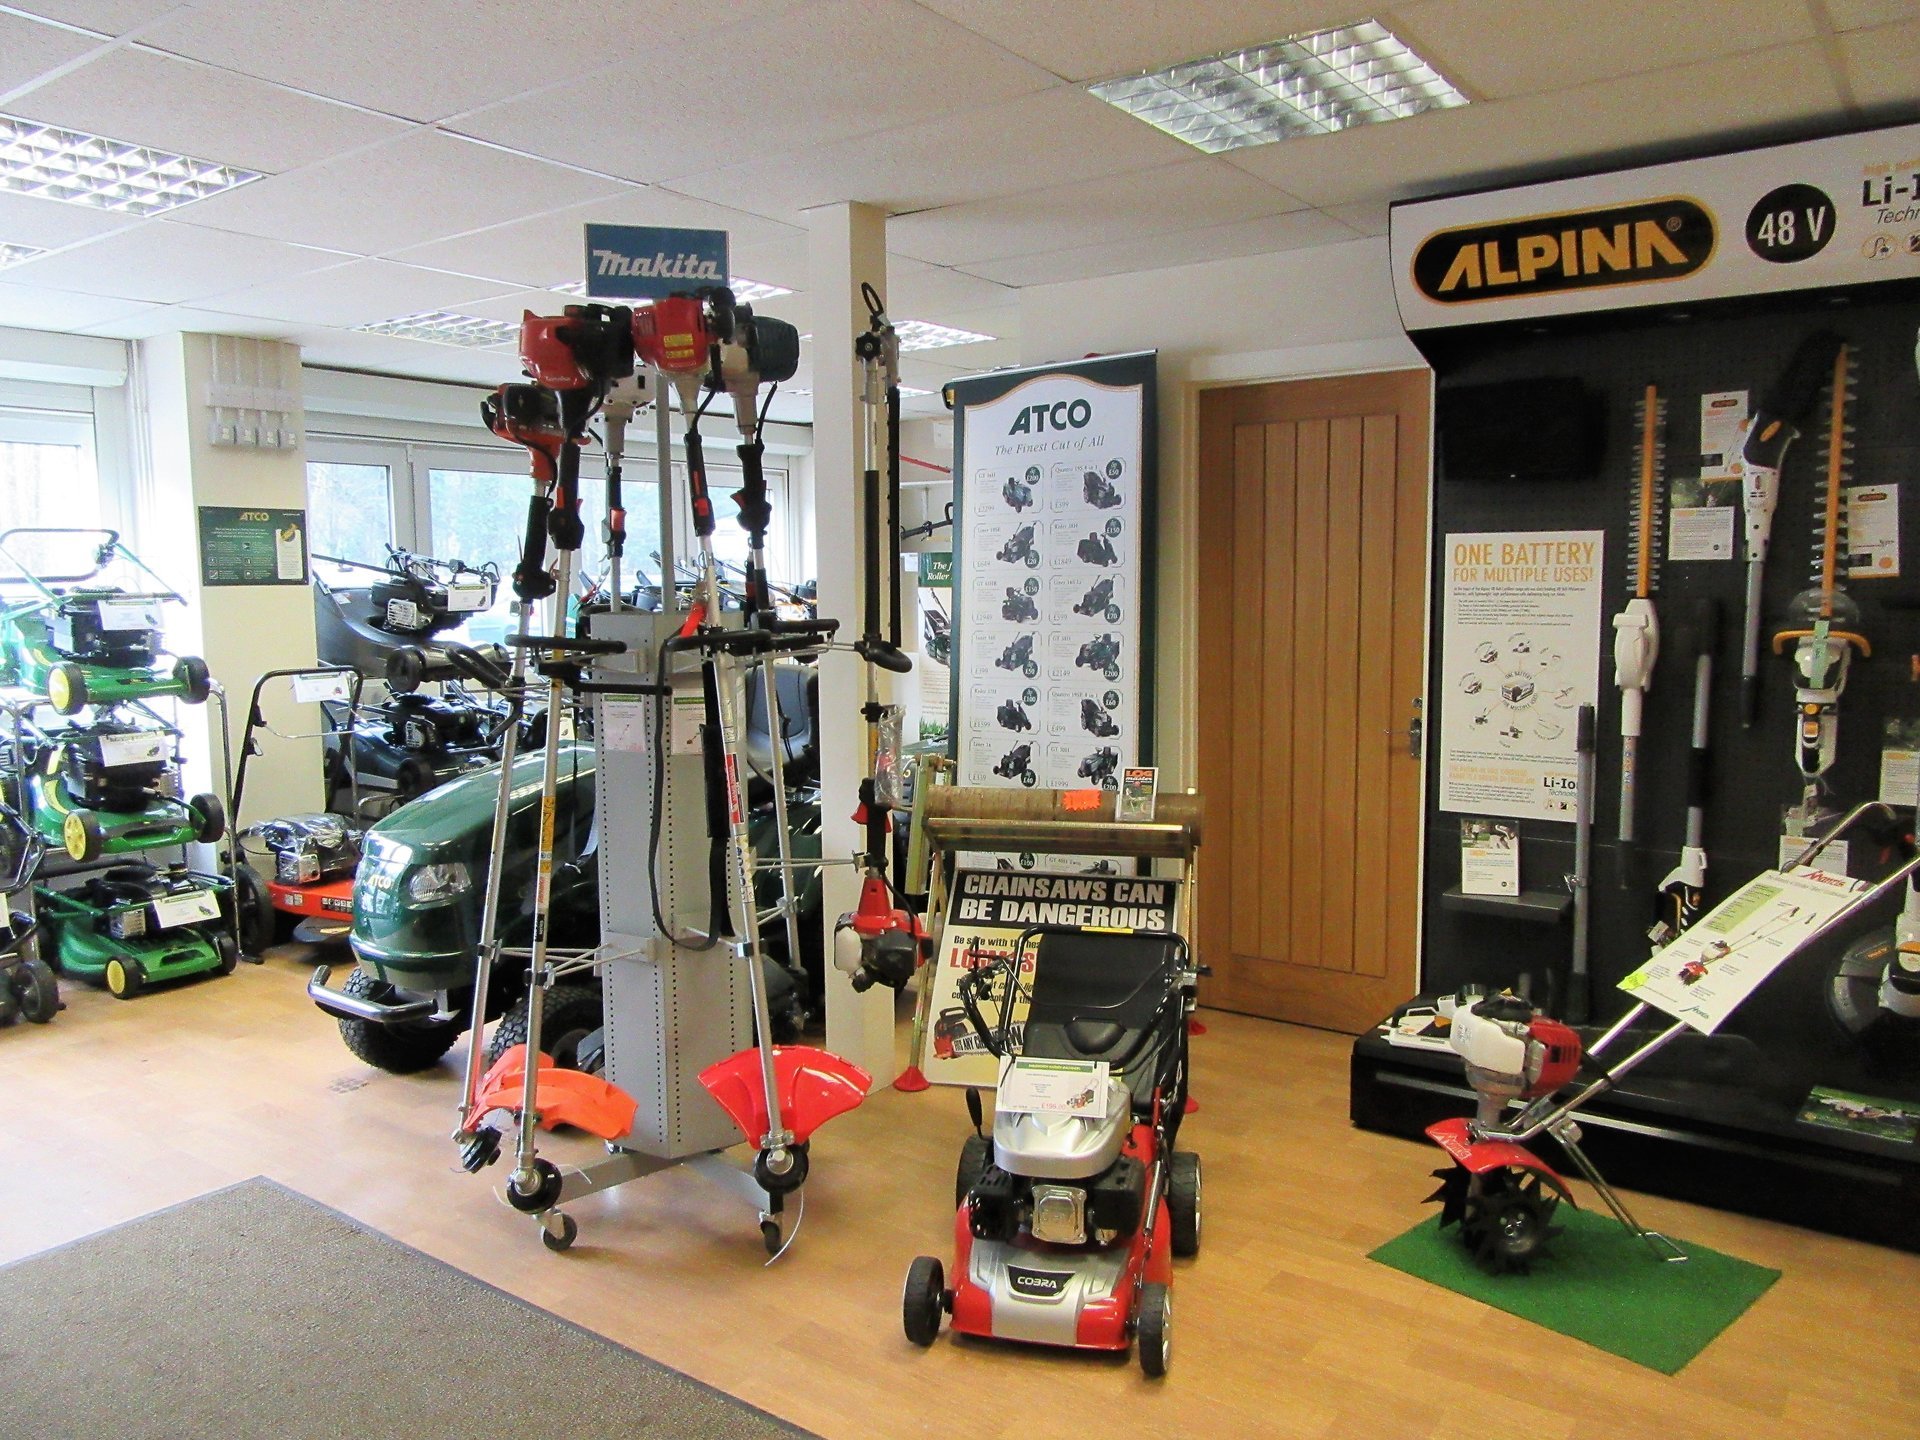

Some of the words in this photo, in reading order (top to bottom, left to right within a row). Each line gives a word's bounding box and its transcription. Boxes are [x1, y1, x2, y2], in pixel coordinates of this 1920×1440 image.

[1438, 220, 1689, 293] ALPINA
[1758, 211, 1795, 248] 48
[1806, 206, 1827, 242] V
[1008, 399, 1092, 435] ATCO
[995, 445, 1012, 455] The
[1016, 442, 1047, 454] Finest
[1051, 440, 1070, 451] Cut
[1074, 436, 1087, 451] of
[1088, 435, 1105, 447] All
[240, 512, 269, 521] ATCO
[1454, 543, 1493, 566] ONE
[1501, 542, 1595, 565] BATTERY
[927, 572, 950, 580] Roller
[1453, 567, 1477, 582] FOR
[1484, 567, 1548, 582] MULTIPLE
[1554, 567, 1594, 582] USES!
[1543, 777, 1578, 790] Li-Io
[963, 874, 1108, 901] CHAINSAWS
[1113, 882, 1164, 904] CAN
[959, 898, 995, 920] BE
[1000, 901, 1166, 931] DANGEROUS
[954, 935, 964, 944] Be
[988, 937, 1008, 947] with
[1017, 1276, 1057, 1289] COBRA
